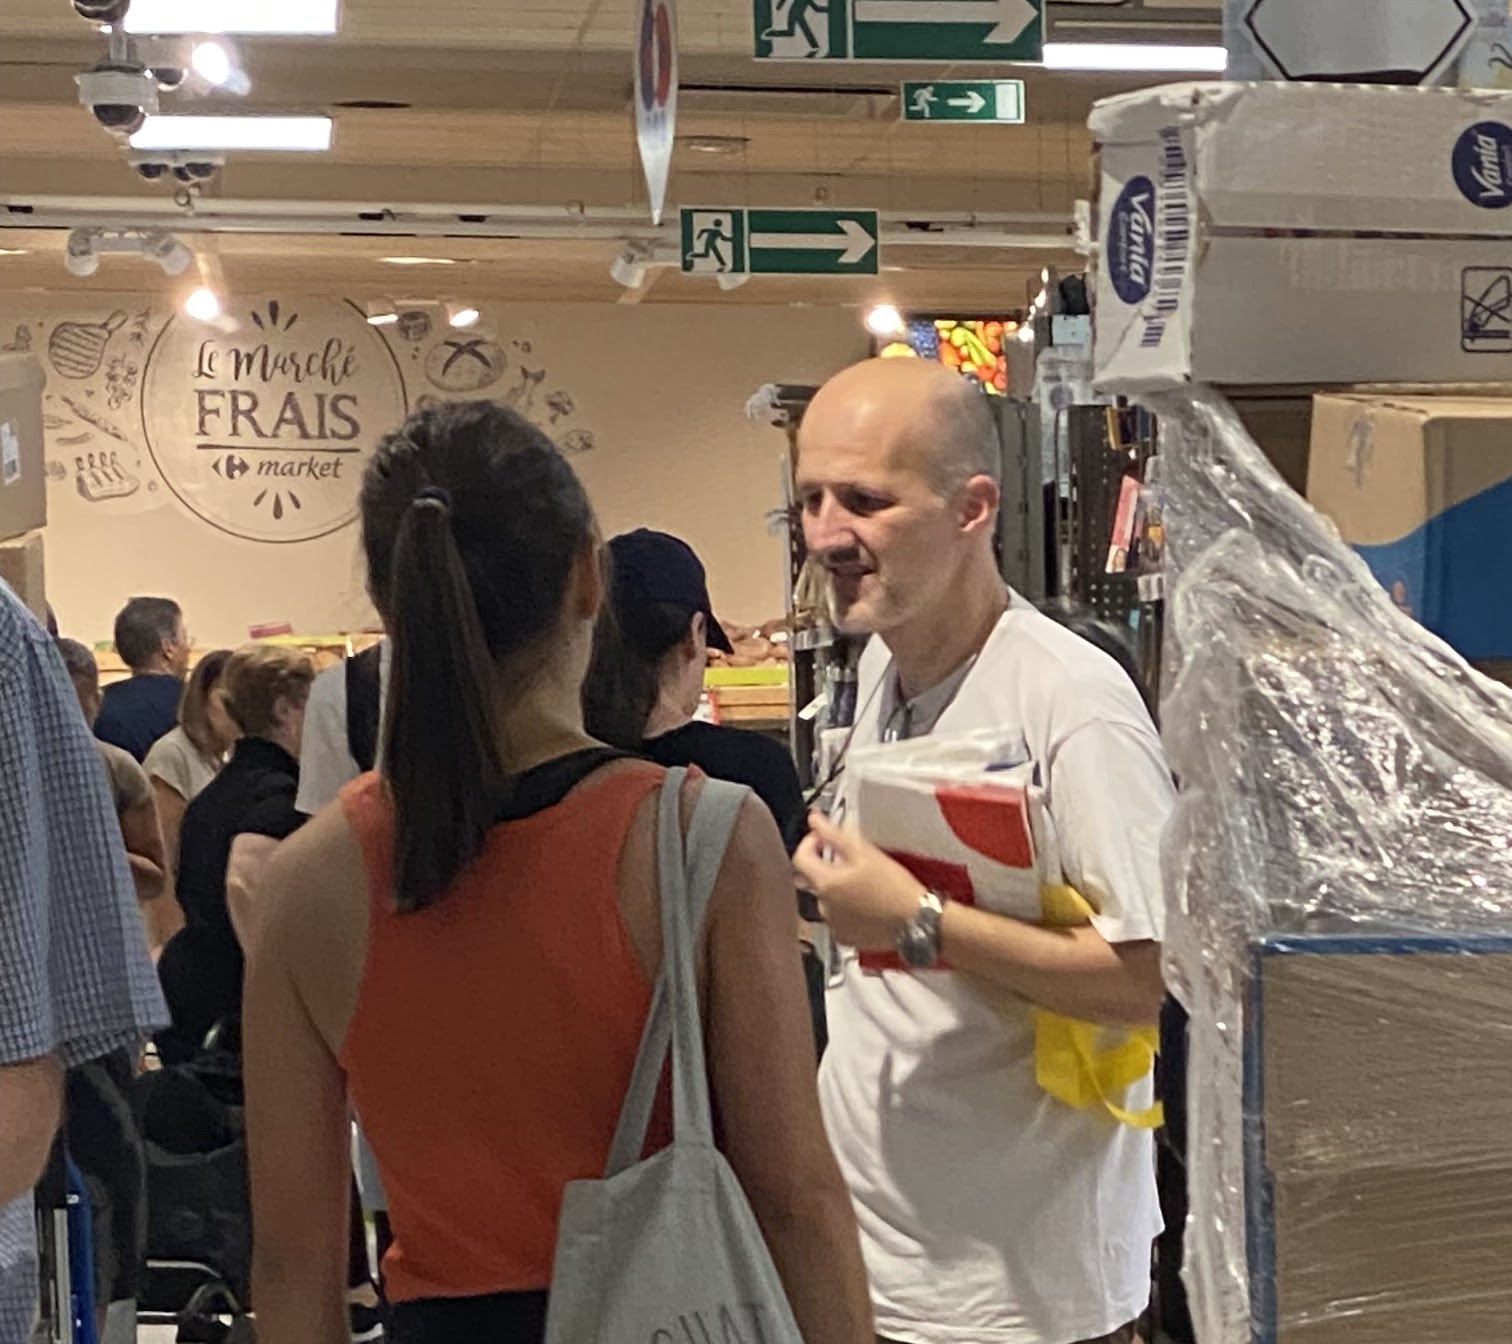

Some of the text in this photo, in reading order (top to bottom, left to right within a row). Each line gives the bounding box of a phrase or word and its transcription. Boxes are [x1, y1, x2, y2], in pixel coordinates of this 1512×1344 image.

[1471, 134, 1504, 197] Vania
[1130, 192, 1152, 285] Vania
[193, 338, 359, 384] Le Marché
[195, 390, 361, 441] FRAIS
[257, 456, 343, 481] market
